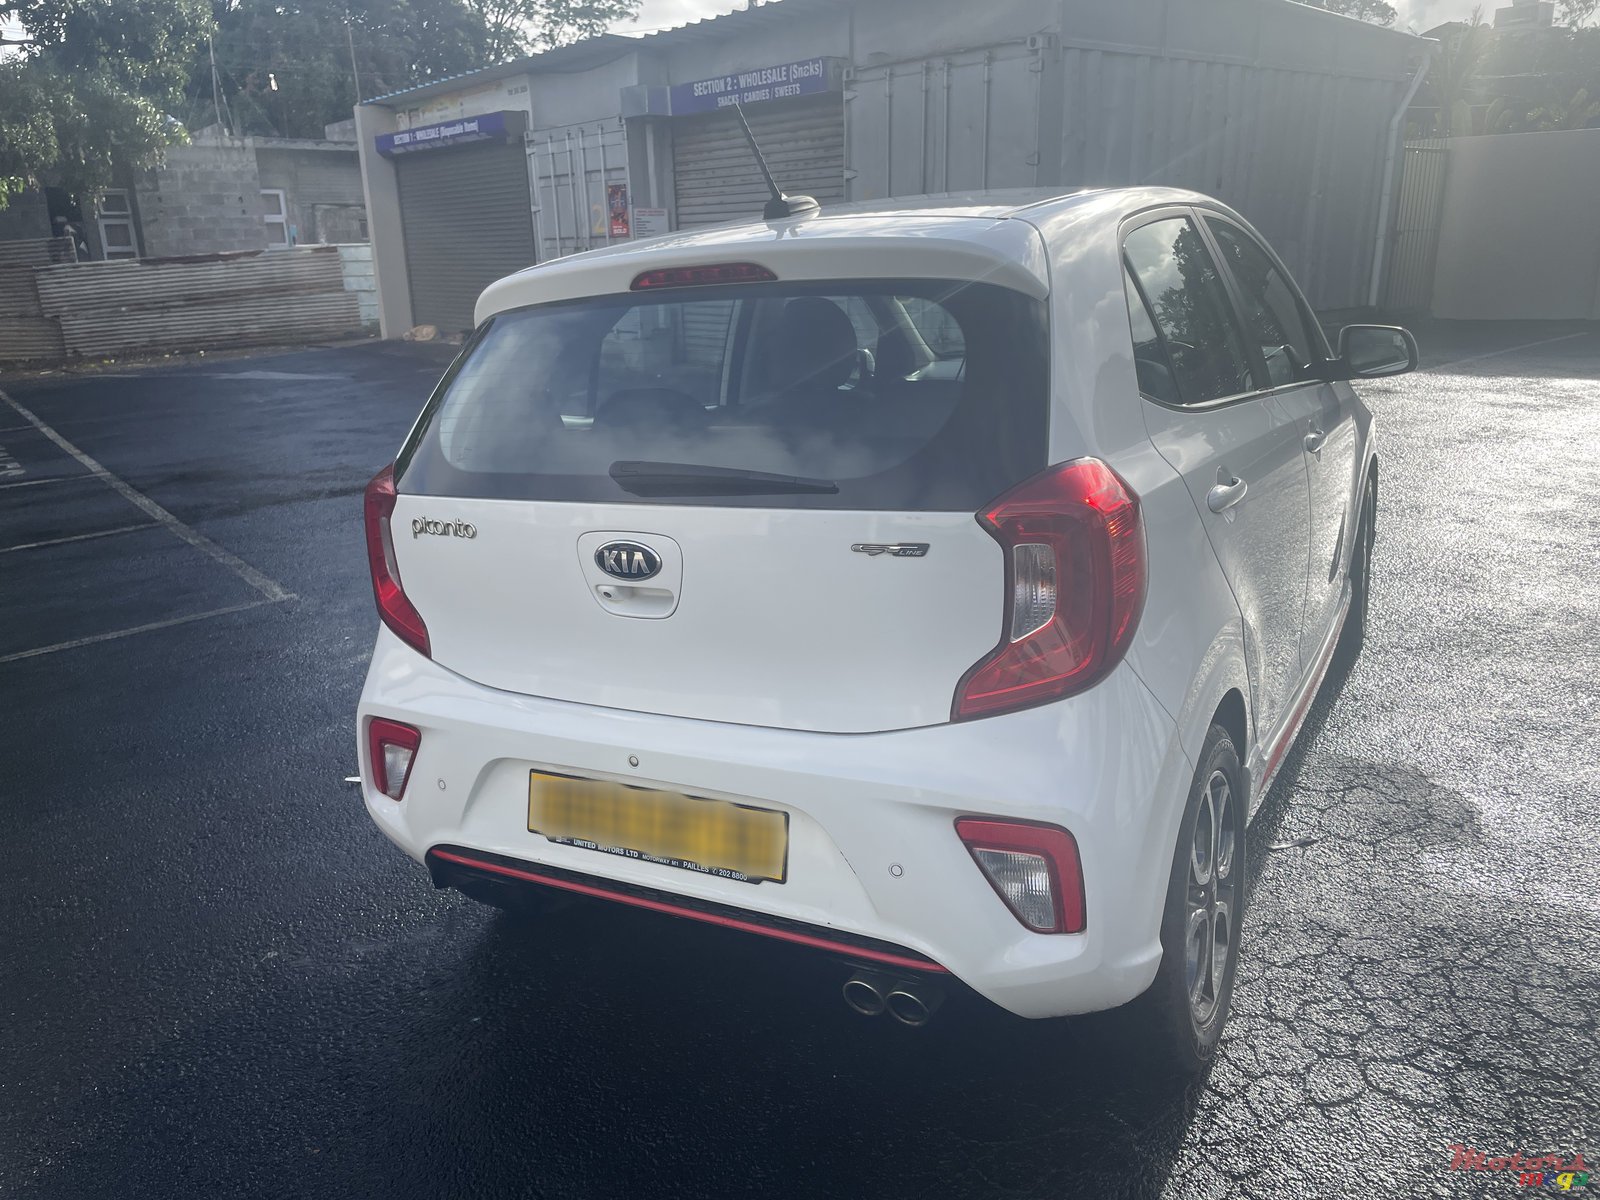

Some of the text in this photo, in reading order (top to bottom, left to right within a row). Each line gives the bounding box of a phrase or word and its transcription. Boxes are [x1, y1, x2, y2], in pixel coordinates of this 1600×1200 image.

[693, 79, 726, 96] SECTION
[726, 77, 732, 91] 2
[739, 67, 786, 88] WHOLESALE
[743, 88, 769, 103] CANDIES
[774, 84, 801, 98] SWEETS
[411, 515, 478, 539] picanto
[603, 549, 651, 574] KIA
[573, 838, 596, 849] UNITED
[597, 843, 625, 855] MOTORS
[625, 849, 639, 858] LTD
[642, 854, 670, 865] MOTORWAY
[683, 861, 710, 873] PAILLES
[719, 869, 731, 878] 202
